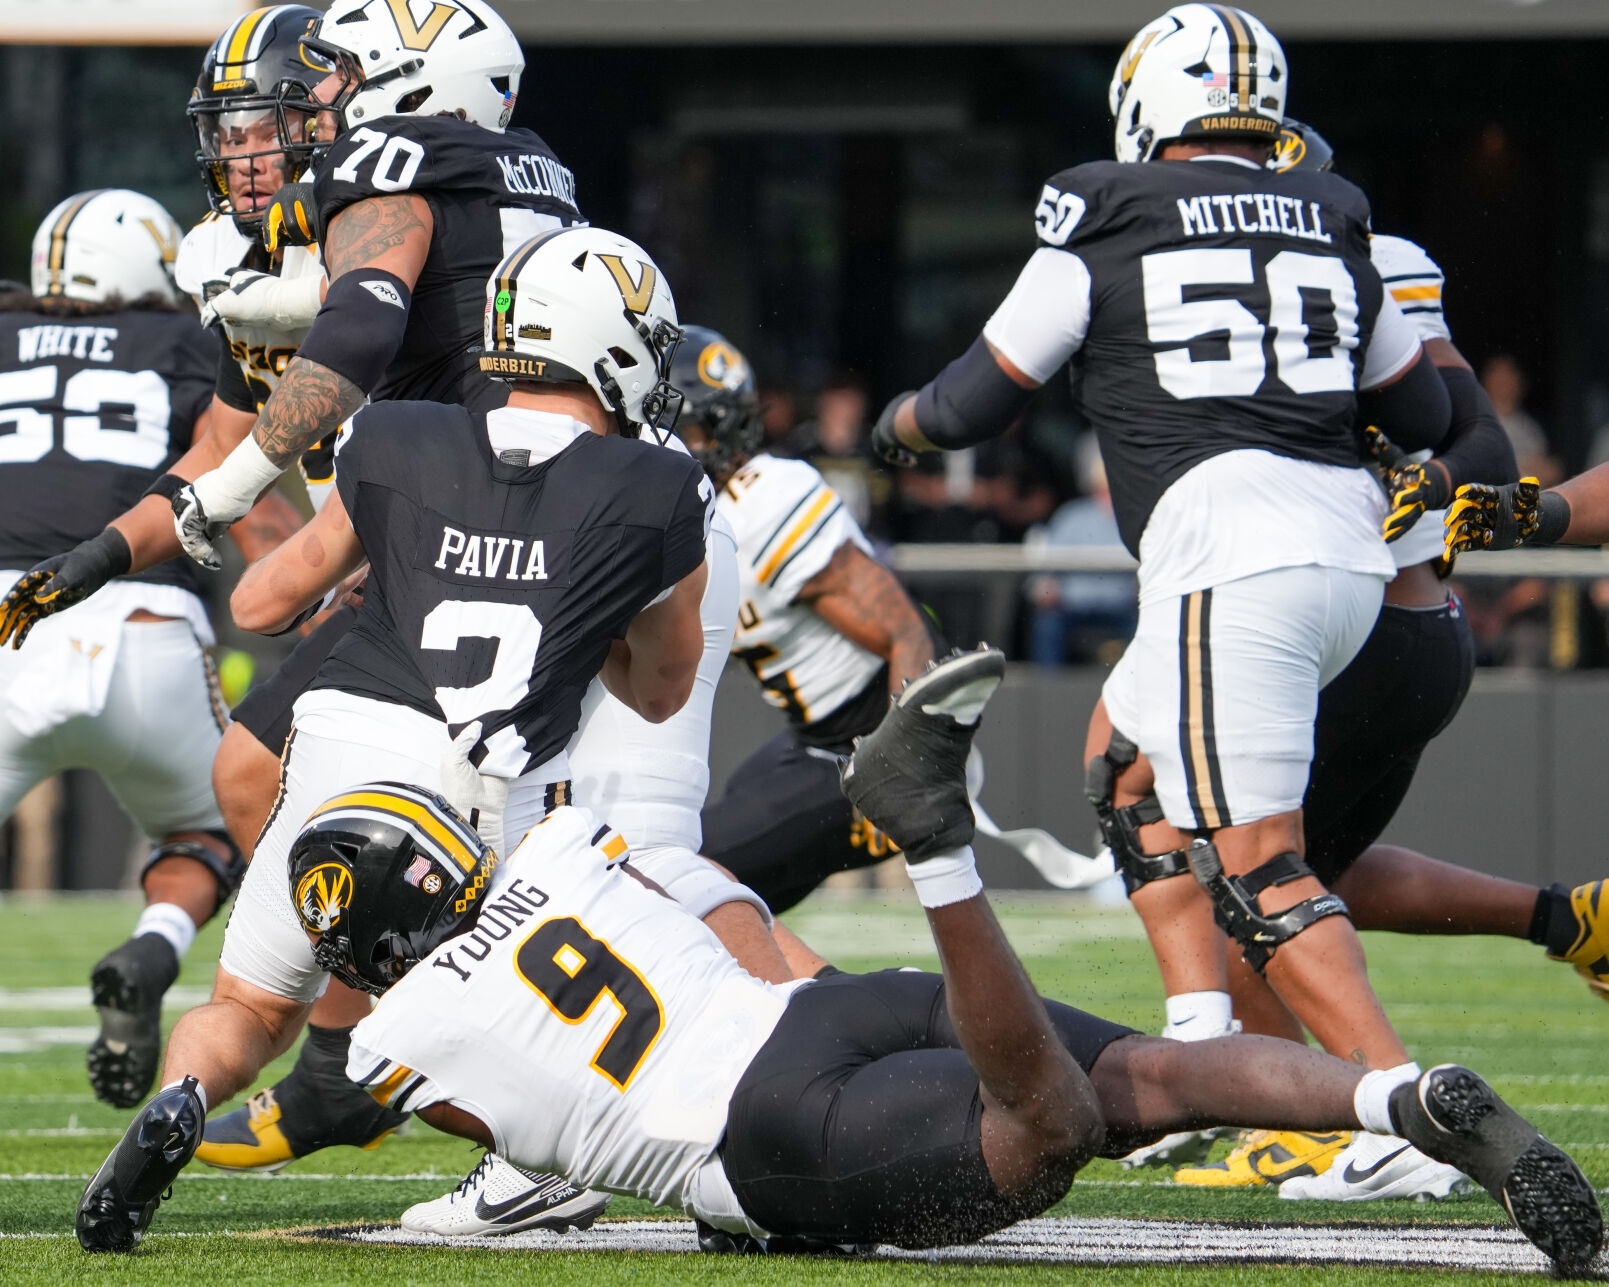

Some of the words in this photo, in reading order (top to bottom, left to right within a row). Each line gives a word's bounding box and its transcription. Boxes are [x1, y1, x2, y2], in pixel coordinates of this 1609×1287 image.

[385, 0, 460, 52] V
[1201, 116, 1277, 133] VANDERBILT
[333, 127, 425, 192] 70
[496, 155, 581, 215] McCONNE
[1035, 184, 1086, 246] 50
[1177, 193, 1332, 244] MITCHELL
[496, 297, 510, 306] C2P
[593, 253, 657, 316] V
[18, 325, 118, 363] WHITE
[505, 323, 513, 338] 2
[1142, 248, 1360, 400] 50
[479, 356, 547, 376] NDERBILT
[0, 365, 171, 469] 53
[434, 526, 548, 581] PAVIA
[421, 599, 543, 778] 2
[432, 878, 549, 983] YOUNG
[513, 914, 666, 1095] 9
[546, 1186, 579, 1207] ALPHA
